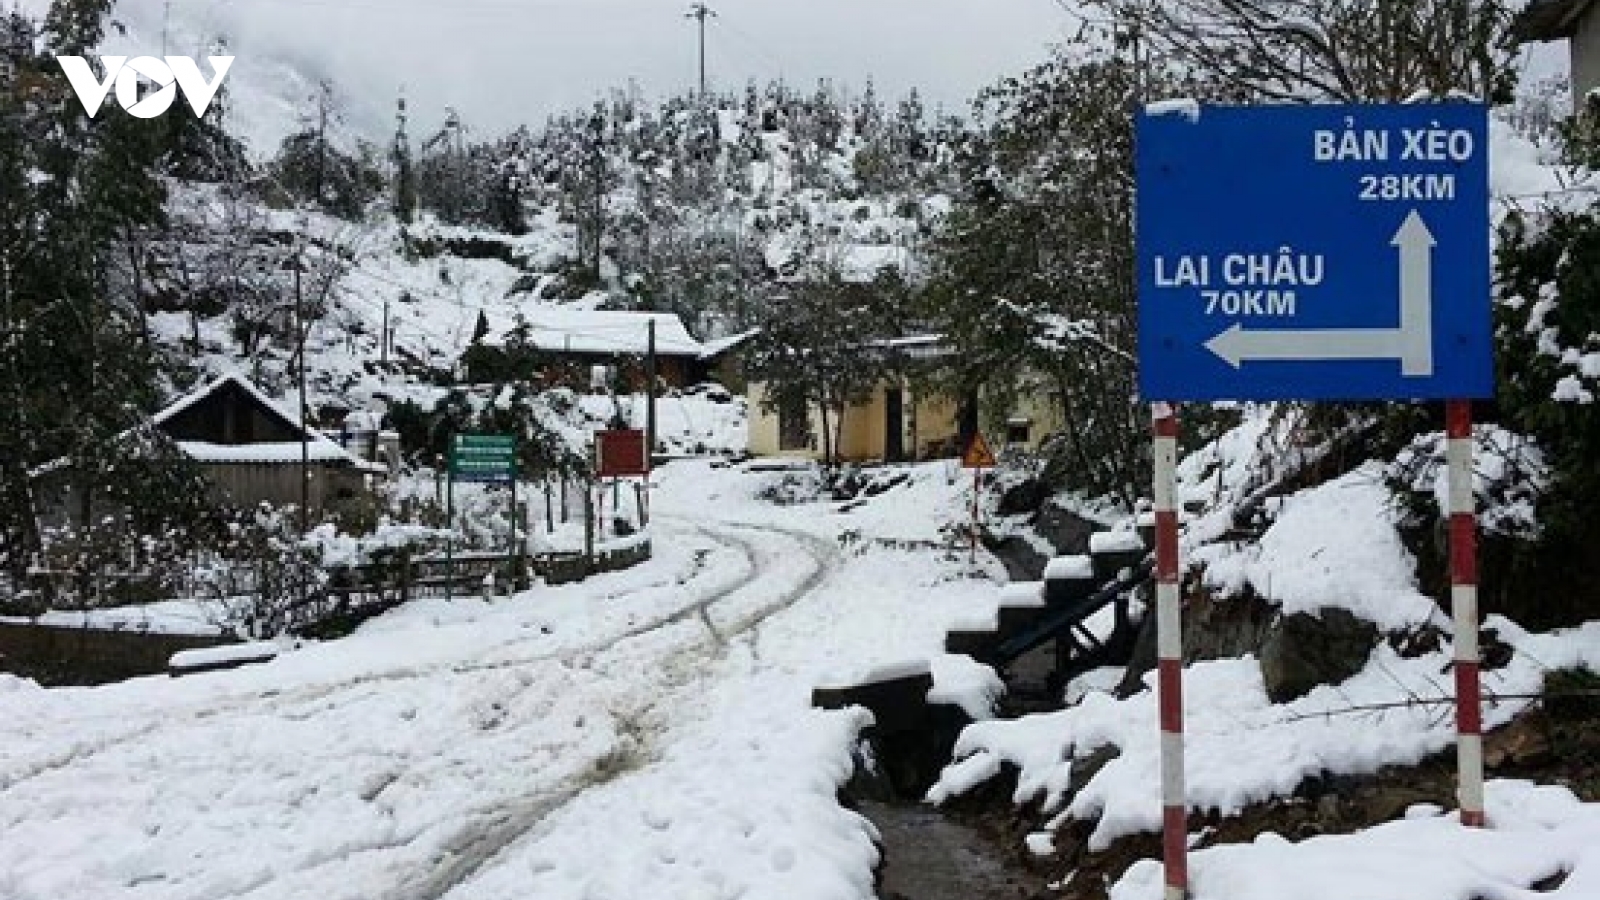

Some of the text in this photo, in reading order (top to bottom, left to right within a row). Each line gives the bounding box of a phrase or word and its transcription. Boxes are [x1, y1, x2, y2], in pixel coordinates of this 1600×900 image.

[1314, 116, 1389, 160] BẢN
[1359, 174, 1456, 200] 28KM
[1154, 245, 1324, 287] LAI CHÂU
[1201, 290, 1296, 317] 70KM
